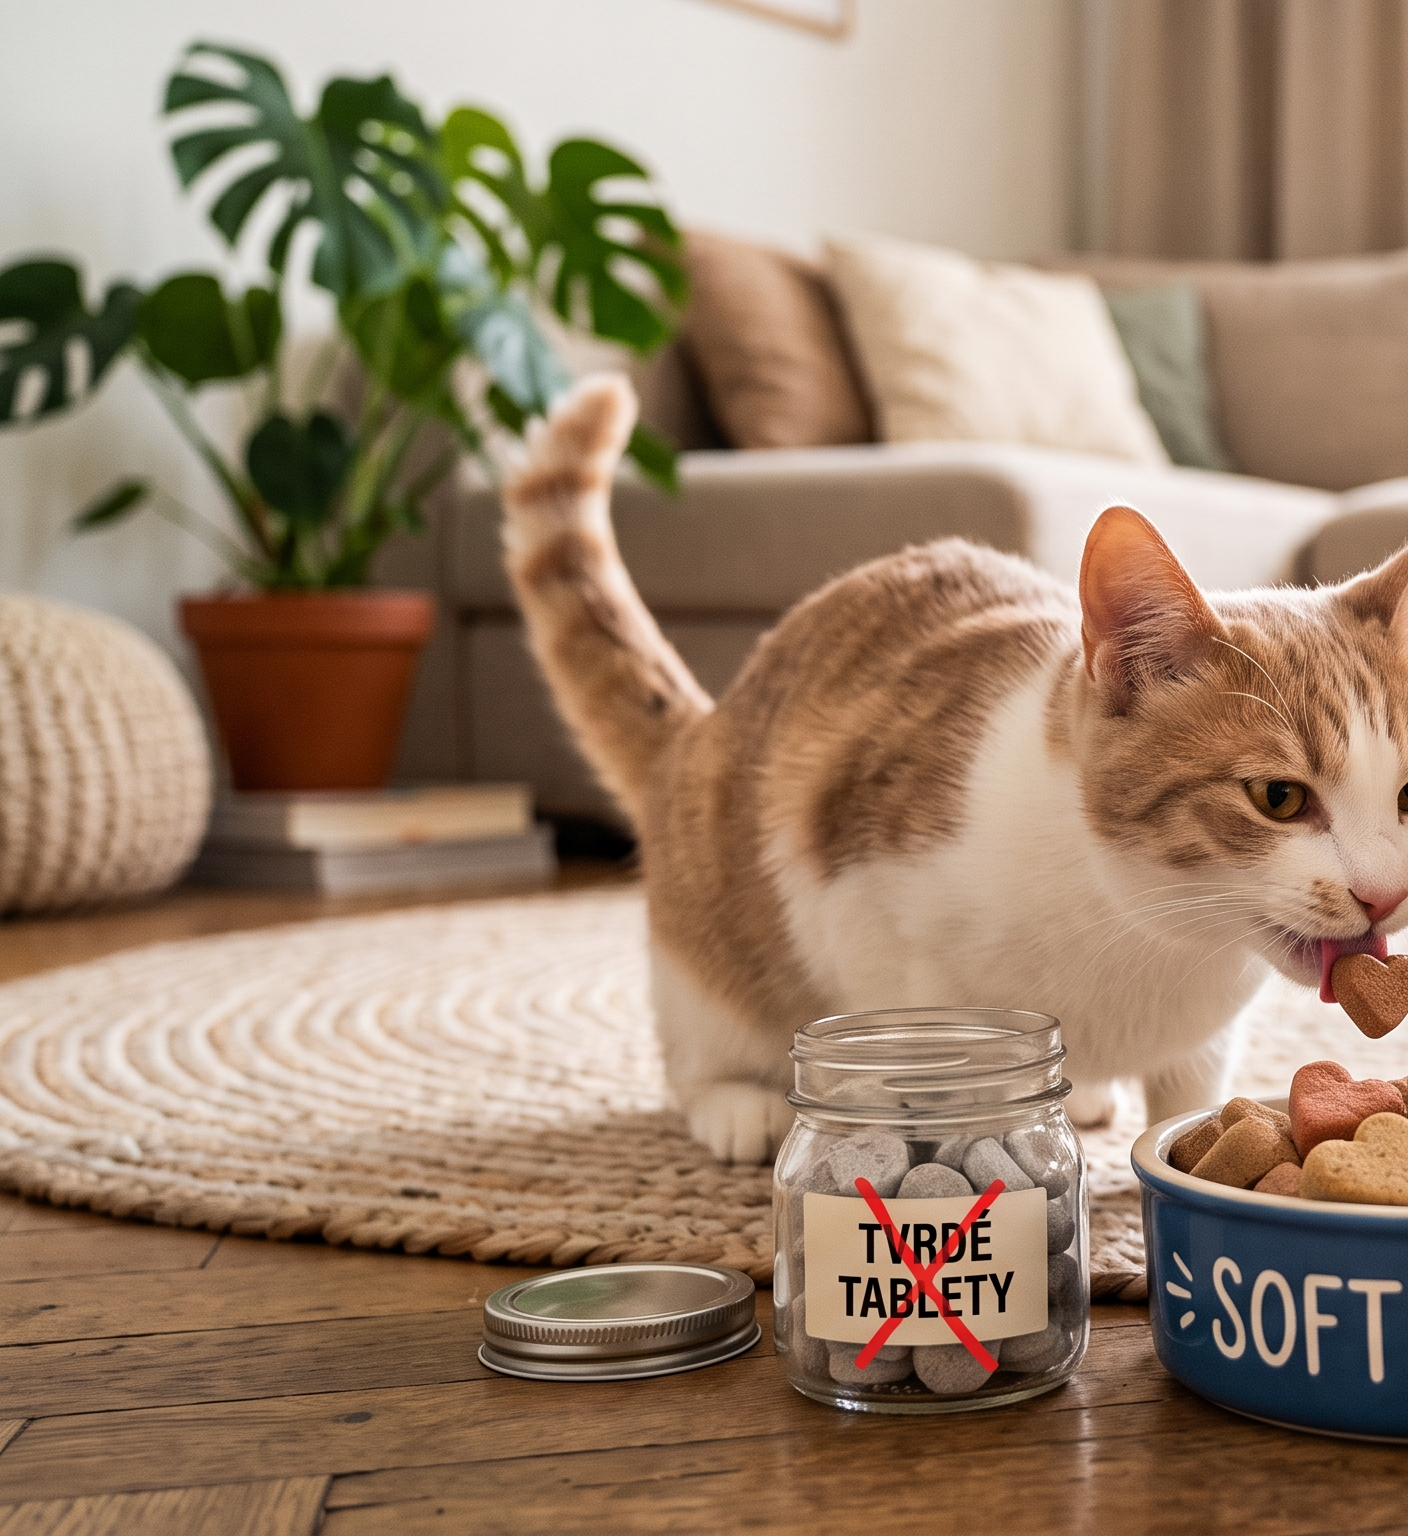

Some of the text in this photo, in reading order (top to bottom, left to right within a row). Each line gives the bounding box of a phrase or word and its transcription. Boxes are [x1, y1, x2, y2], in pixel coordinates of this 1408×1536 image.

[858, 1209, 993, 1264] TVRDÉ
[838, 1271, 1015, 1319] TABLETY
[1212, 1256, 1402, 1384] SOFT
